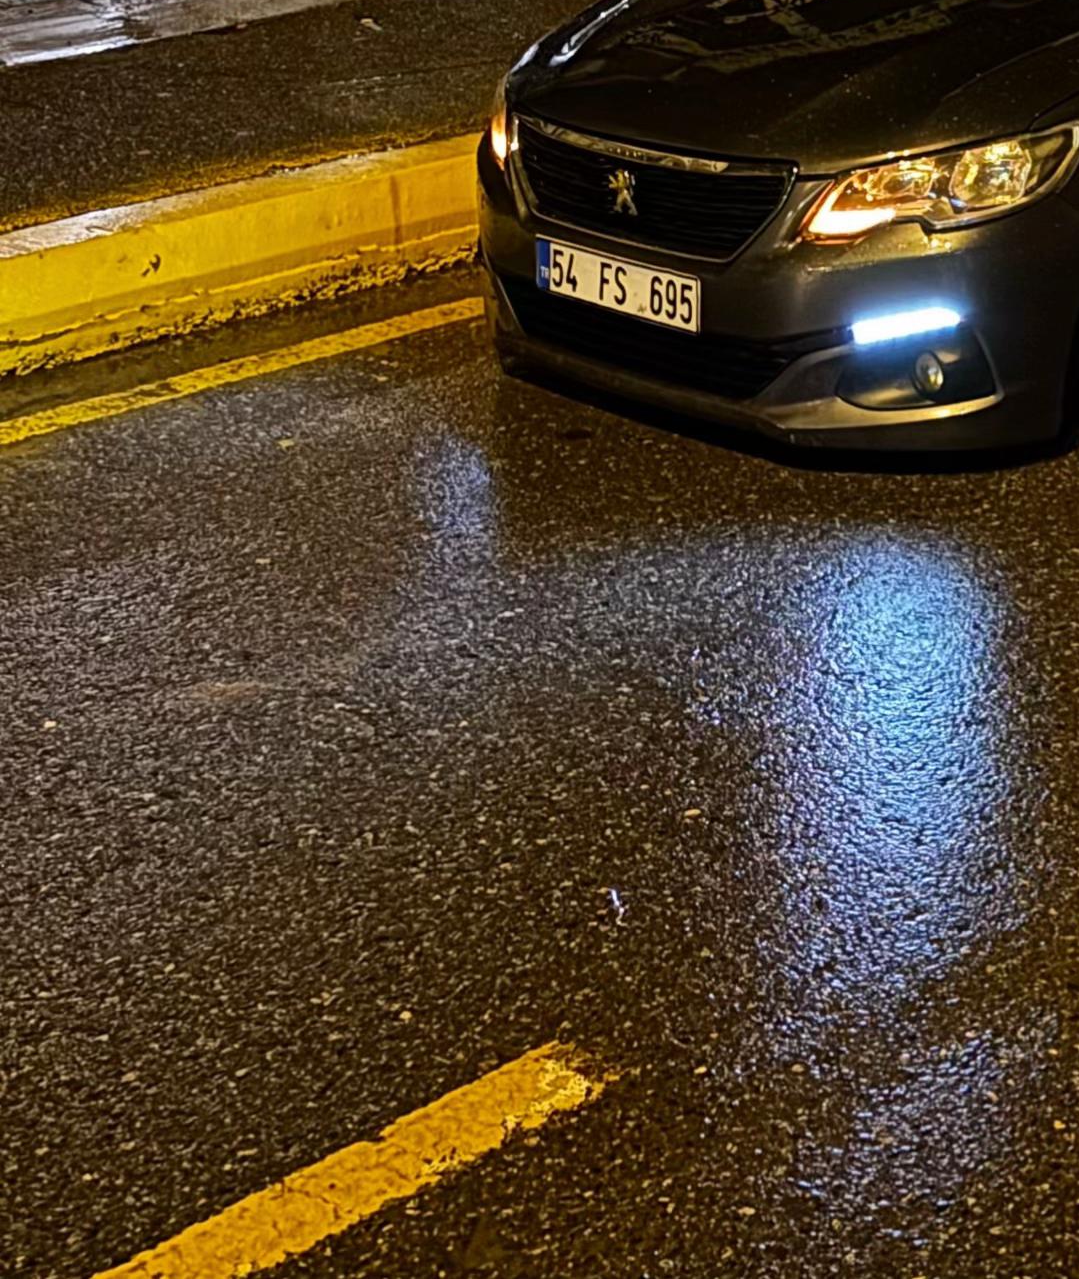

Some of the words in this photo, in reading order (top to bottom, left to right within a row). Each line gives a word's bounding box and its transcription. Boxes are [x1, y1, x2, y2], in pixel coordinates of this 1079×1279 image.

[552, 249, 577, 292] 54
[599, 262, 627, 305] FS
[650, 276, 693, 324] 695
